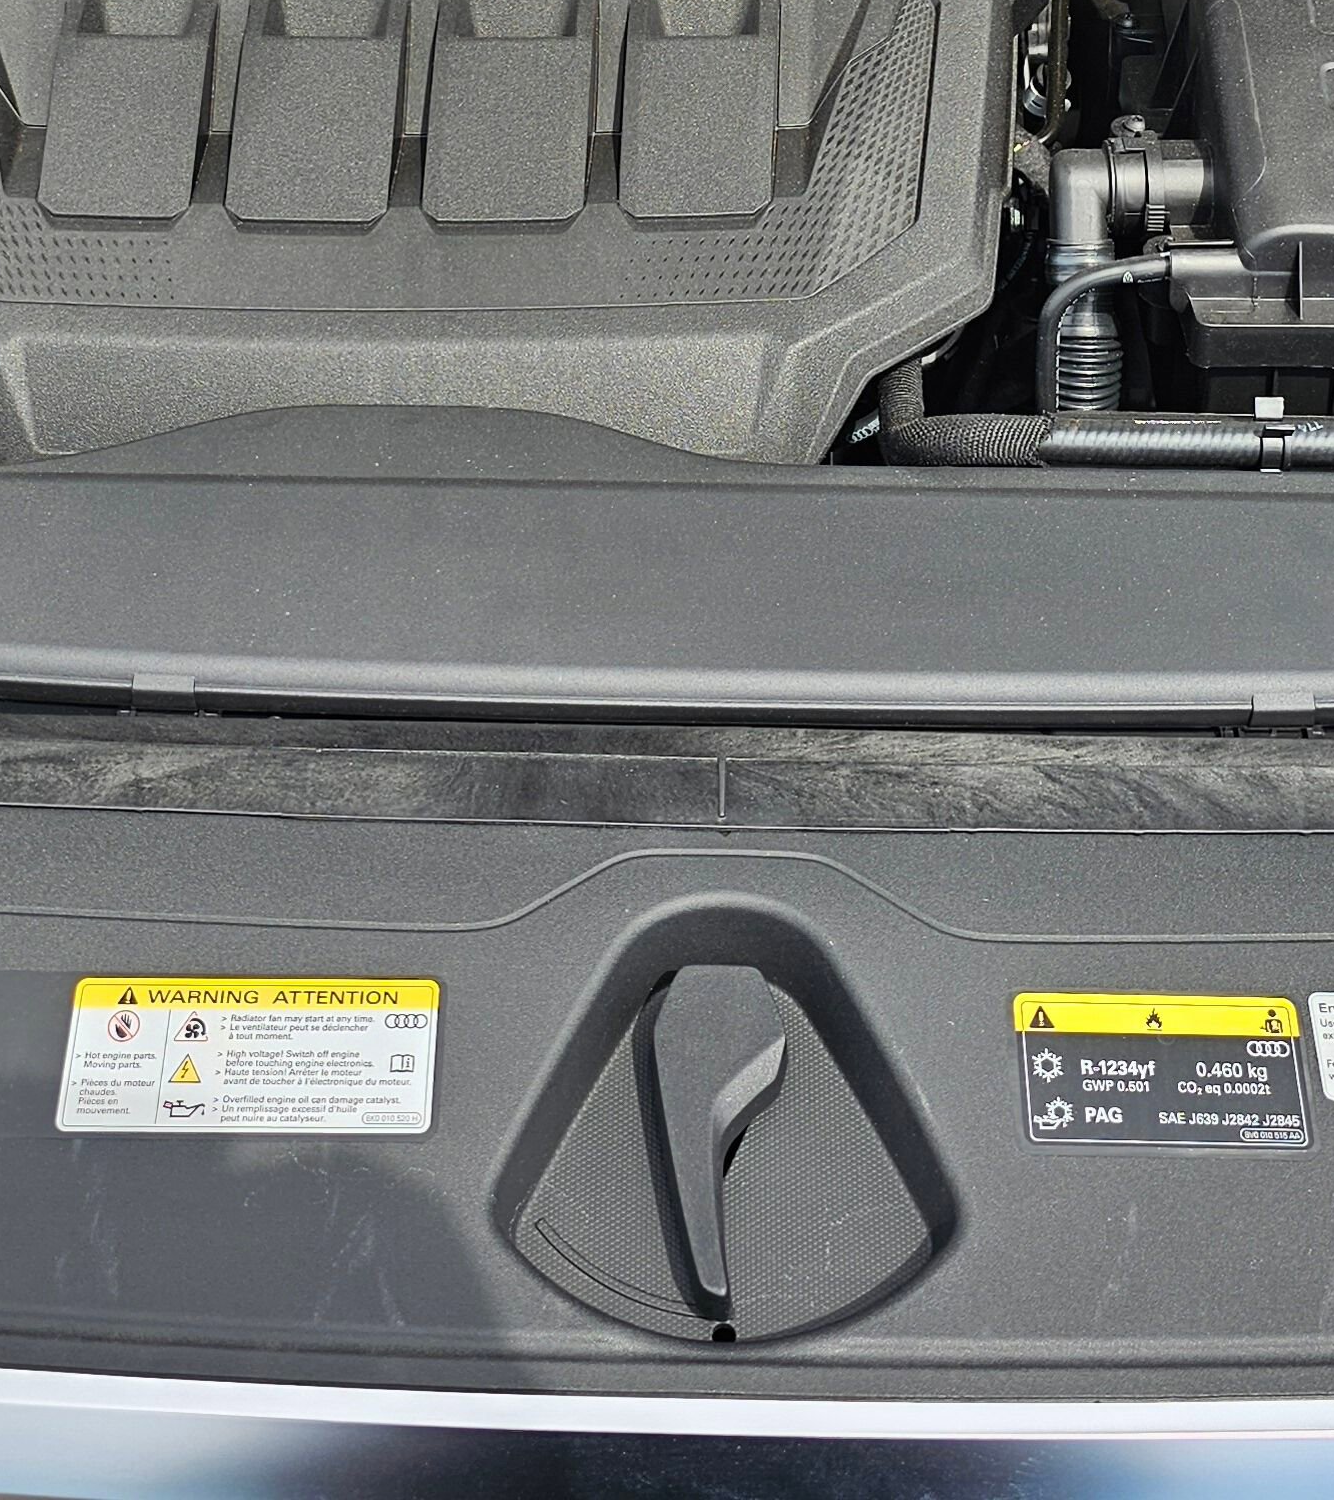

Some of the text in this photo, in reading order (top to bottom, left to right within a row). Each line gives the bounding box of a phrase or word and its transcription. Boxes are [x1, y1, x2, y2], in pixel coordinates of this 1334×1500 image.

[148, 989, 398, 1005] WARNING ATTENTION
[227, 1051, 246, 1060] High
[249, 1051, 283, 1060] voltage!
[331, 1052, 359, 1060] engine
[84, 1061, 116, 1069] Moving
[226, 1059, 253, 1067] before
[256, 1060, 293, 1068] touching
[289, 1068, 319, 1076] Arrêter
[1081, 1059, 1155, 1079] R-1234yf
[1196, 1062, 1267, 1081] 0.460 kg
[1083, 1080, 1149, 1092] GWP 0.501
[1205, 1084, 1221, 1096] eq
[1224, 1083, 1272, 1094] 0.0002t
[267, 1097, 296, 1105] engine
[329, 1096, 363, 1105] damage
[366, 1097, 401, 1105] catalyst.
[237, 1106, 289, 1114] remplissage
[1085, 1106, 1123, 1123] PAG
[220, 1115, 239, 1123] peut
[280, 1115, 326, 1123] catalyseur.
[1159, 1112, 1300, 1127] SAE J639 J2842 J2845
